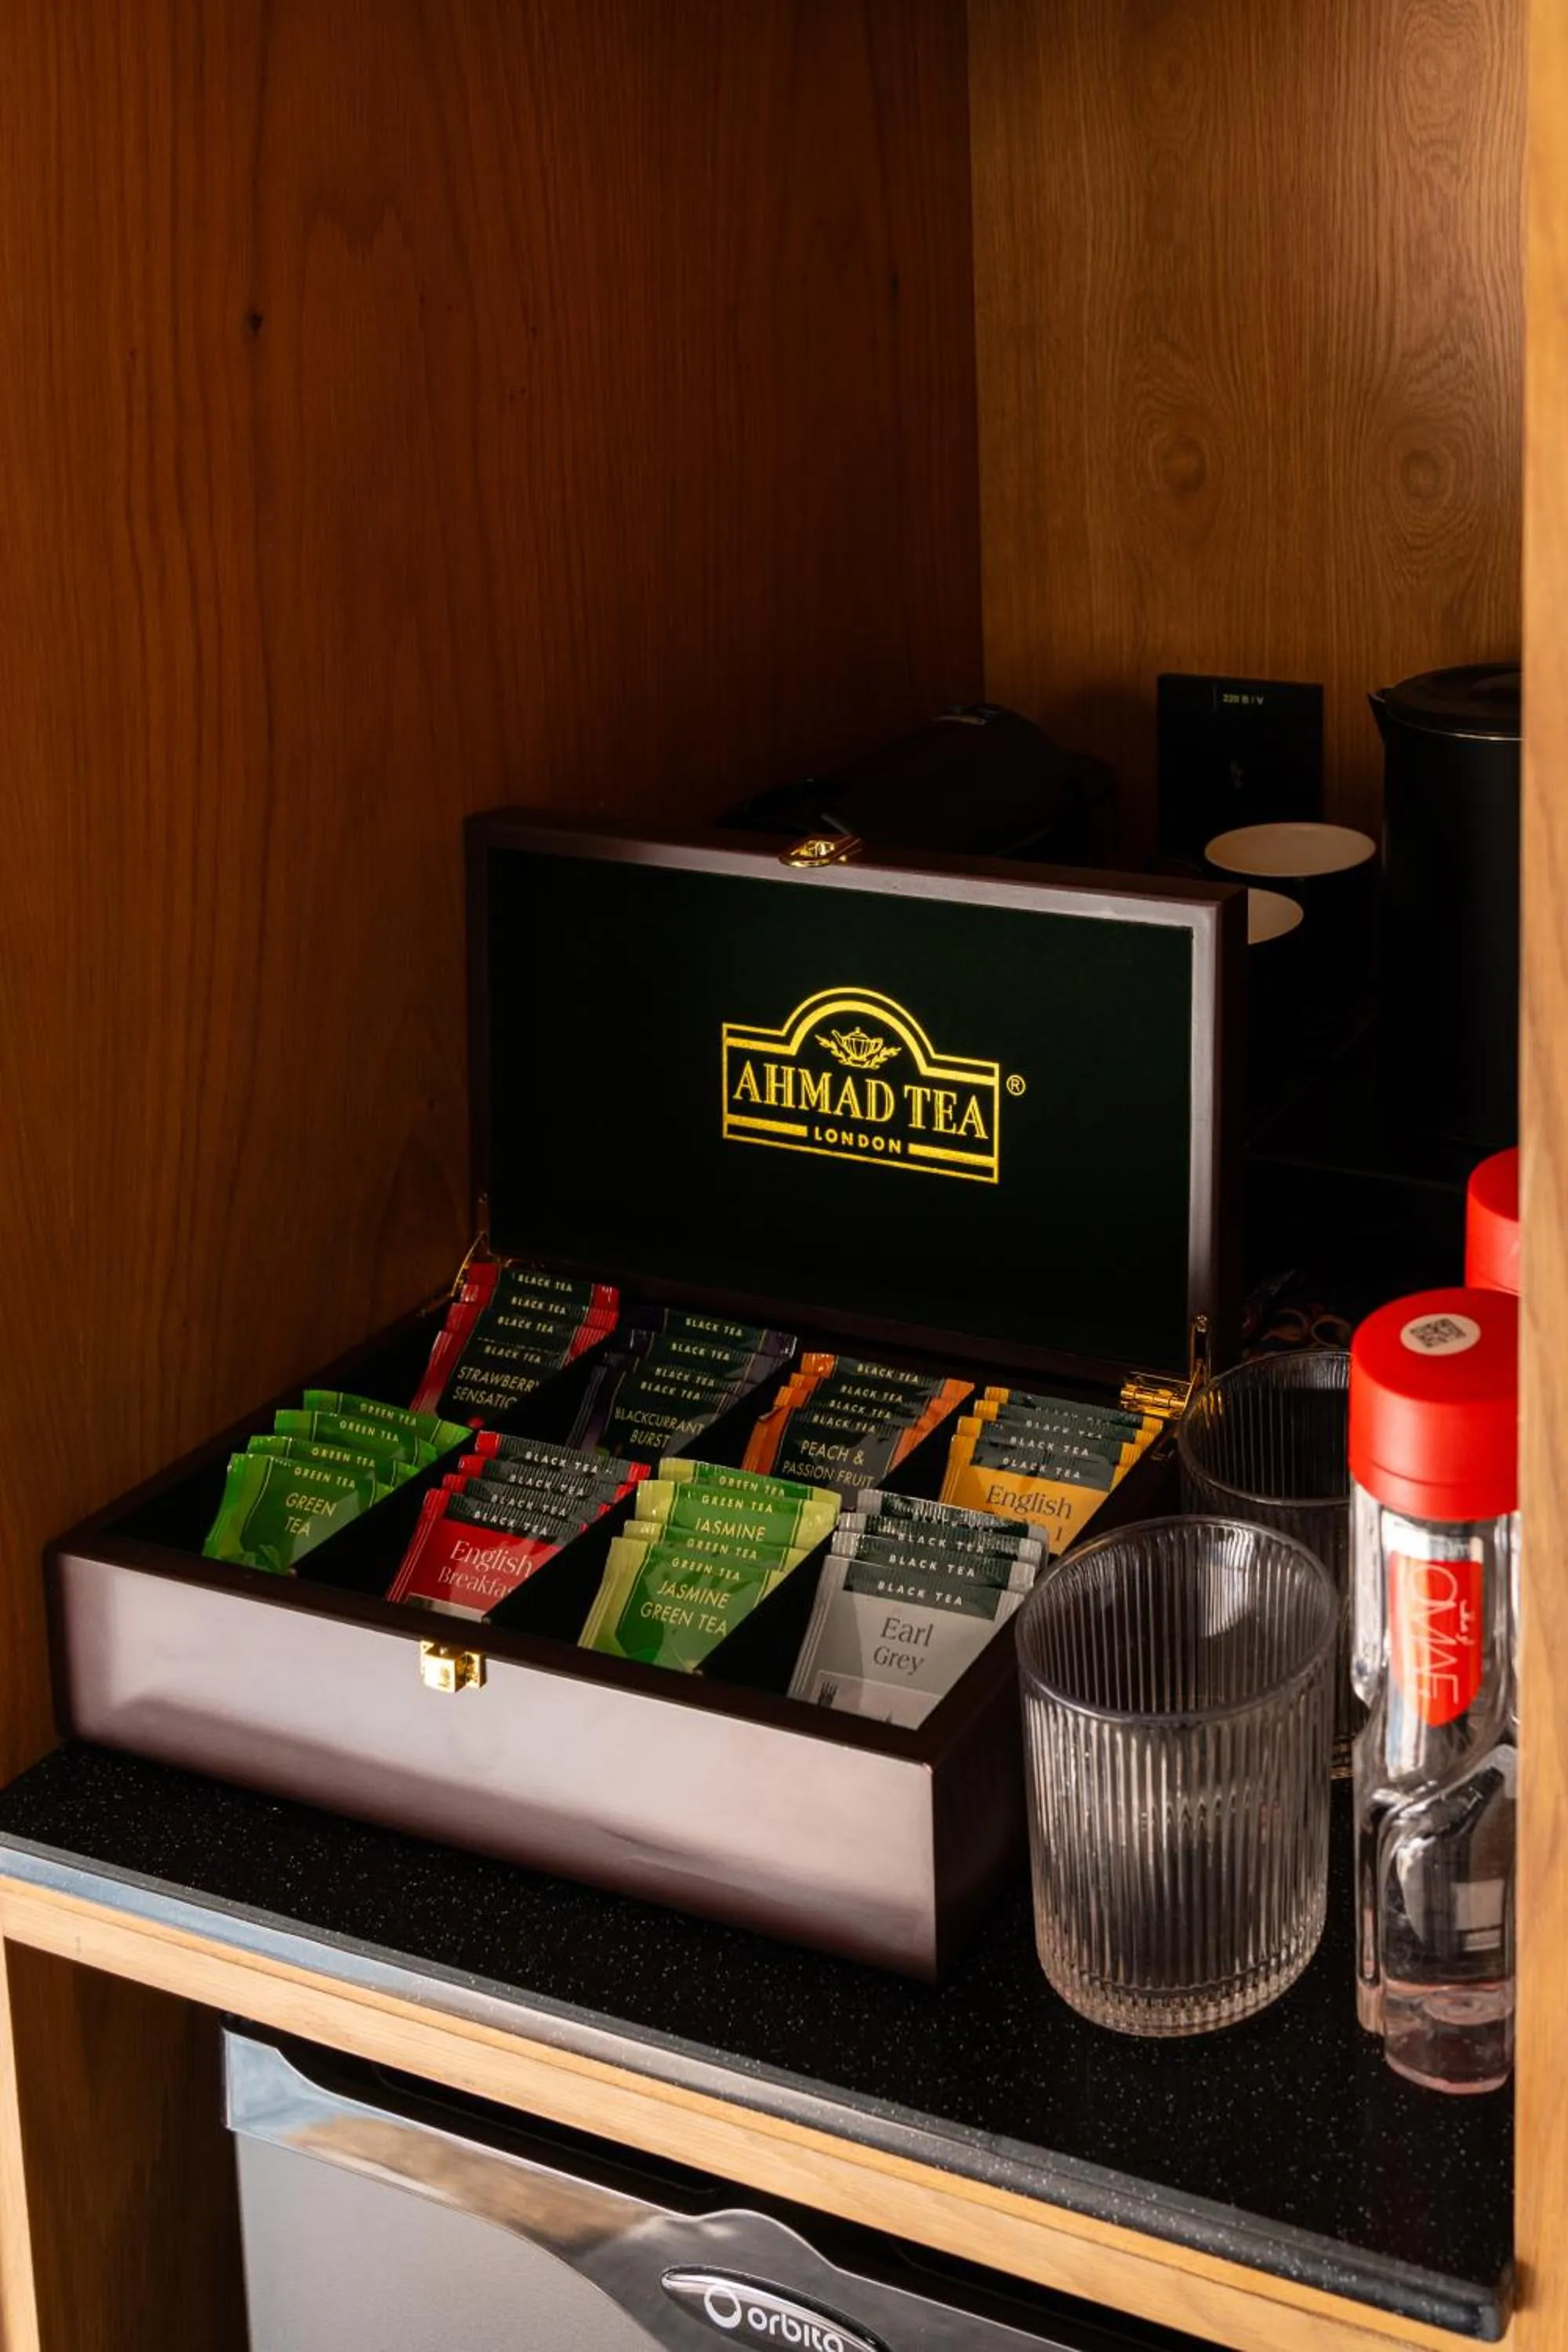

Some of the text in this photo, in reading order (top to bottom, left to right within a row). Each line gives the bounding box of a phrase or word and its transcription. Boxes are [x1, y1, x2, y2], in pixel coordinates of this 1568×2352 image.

[732, 1059, 895, 1123] AHMAD
[904, 1084, 989, 1141] TEA
[814, 1125, 902, 1155] LONDON
[517, 1272, 573, 1294] BLACK TEA
[510, 1295, 566, 1315] BLACK TEA
[497, 1316, 554, 1334] BLACK TEA
[684, 1316, 743, 1338] BLACK TEA
[483, 1344, 542, 1364] BLACK TEA
[670, 1341, 731, 1361] BLACK TEA
[655, 1367, 716, 1387] BLACK TEA
[856, 1363, 920, 1384] BLACK TEA
[640, 1381, 701, 1401] BLACK TEA
[840, 1384, 903, 1403] BLACK TEA
[359, 1403, 418, 1427] GREEN TEA
[614, 1406, 706, 1436] BLACKCURRANT
[829, 1399, 892, 1420] BLACK TEA
[339, 1419, 400, 1443] GREEN TEA
[811, 1414, 876, 1433] BLACK TEA
[630, 1428, 672, 1450] BURST
[1009, 1436, 1090, 1456] BLACK TEA
[311, 1446, 376, 1468] GREEN TEA
[524, 1450, 599, 1474] BLACK TEA
[800, 1439, 865, 1465] PEACH &
[294, 1466, 357, 1489] GREEN TEA
[781, 1459, 876, 1489] PASSION FRUIT
[1003, 1457, 1081, 1479] BLACK TEA
[510, 1473, 586, 1497] BLACK TEA
[718, 1475, 786, 1497] GREEN TEA
[285, 1492, 338, 1518] GREEN
[491, 1494, 568, 1518] BLACK TEA
[701, 1493, 774, 1514] GREEN TEA
[985, 1484, 1073, 1520] English
[284, 1515, 312, 1537] TEA
[472, 1510, 549, 1537] BLACK TEA
[686, 1537, 758, 1560] GREEN TEA
[898, 1532, 948, 1549] BLACK
[449, 1538, 533, 1579] English
[671, 1556, 741, 1582] GREEN TEA
[888, 1553, 975, 1578] BLACK TEA
[437, 1565, 514, 1599] Breakfa
[877, 1580, 964, 1607] BLACK TEA
[656, 1580, 731, 1610] JASMINE
[639, 1601, 728, 1638] GREEN TEA
[880, 1616, 935, 1647] Earl
[872, 1645, 926, 1677] Grey
